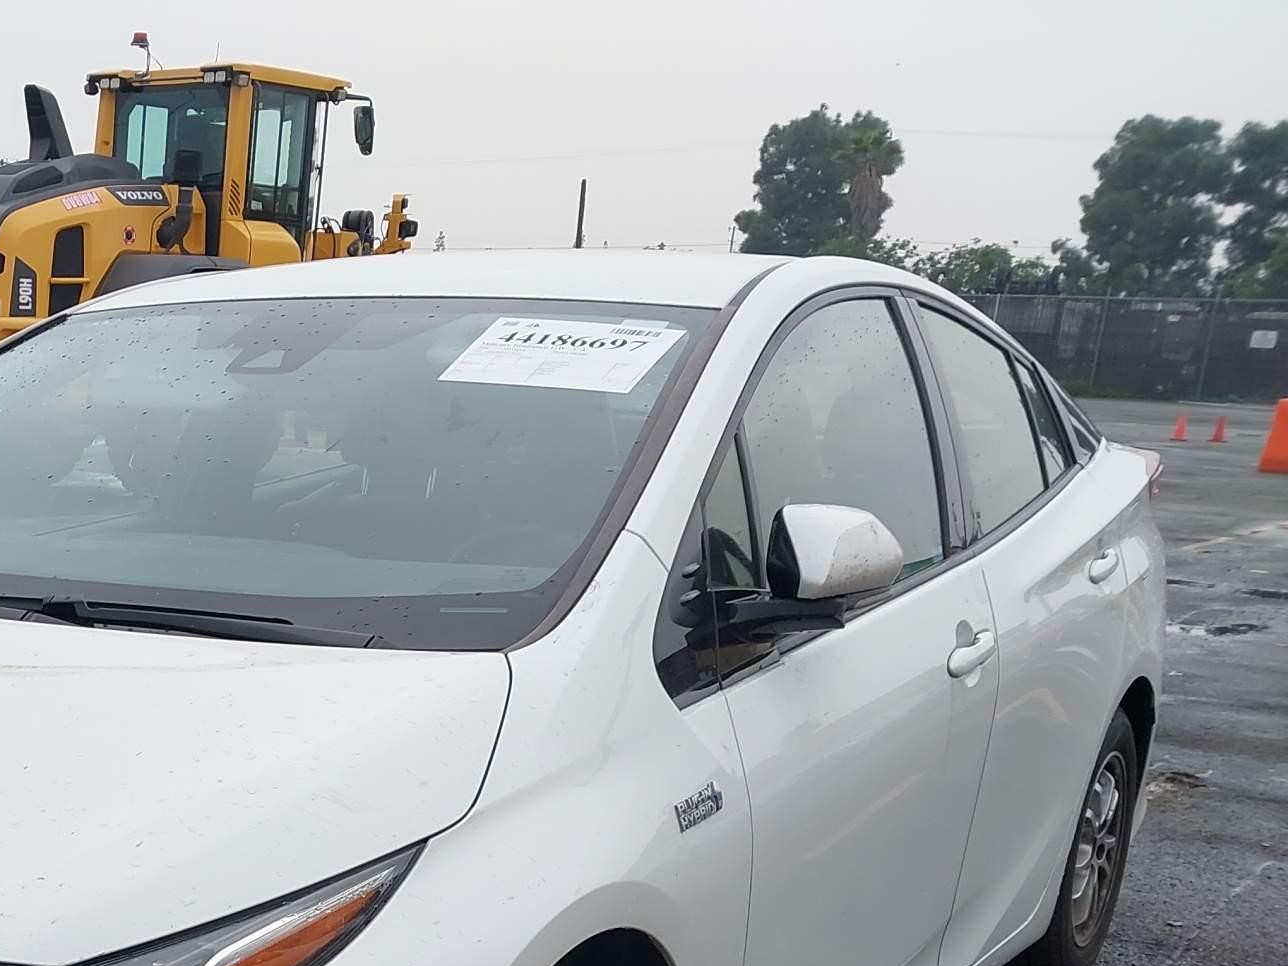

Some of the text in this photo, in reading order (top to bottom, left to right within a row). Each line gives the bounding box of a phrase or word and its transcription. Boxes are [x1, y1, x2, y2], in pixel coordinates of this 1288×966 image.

[116, 191, 163, 201] VOLVO
[18, 278, 32, 310] L90H
[498, 331, 649, 352] 44186697
